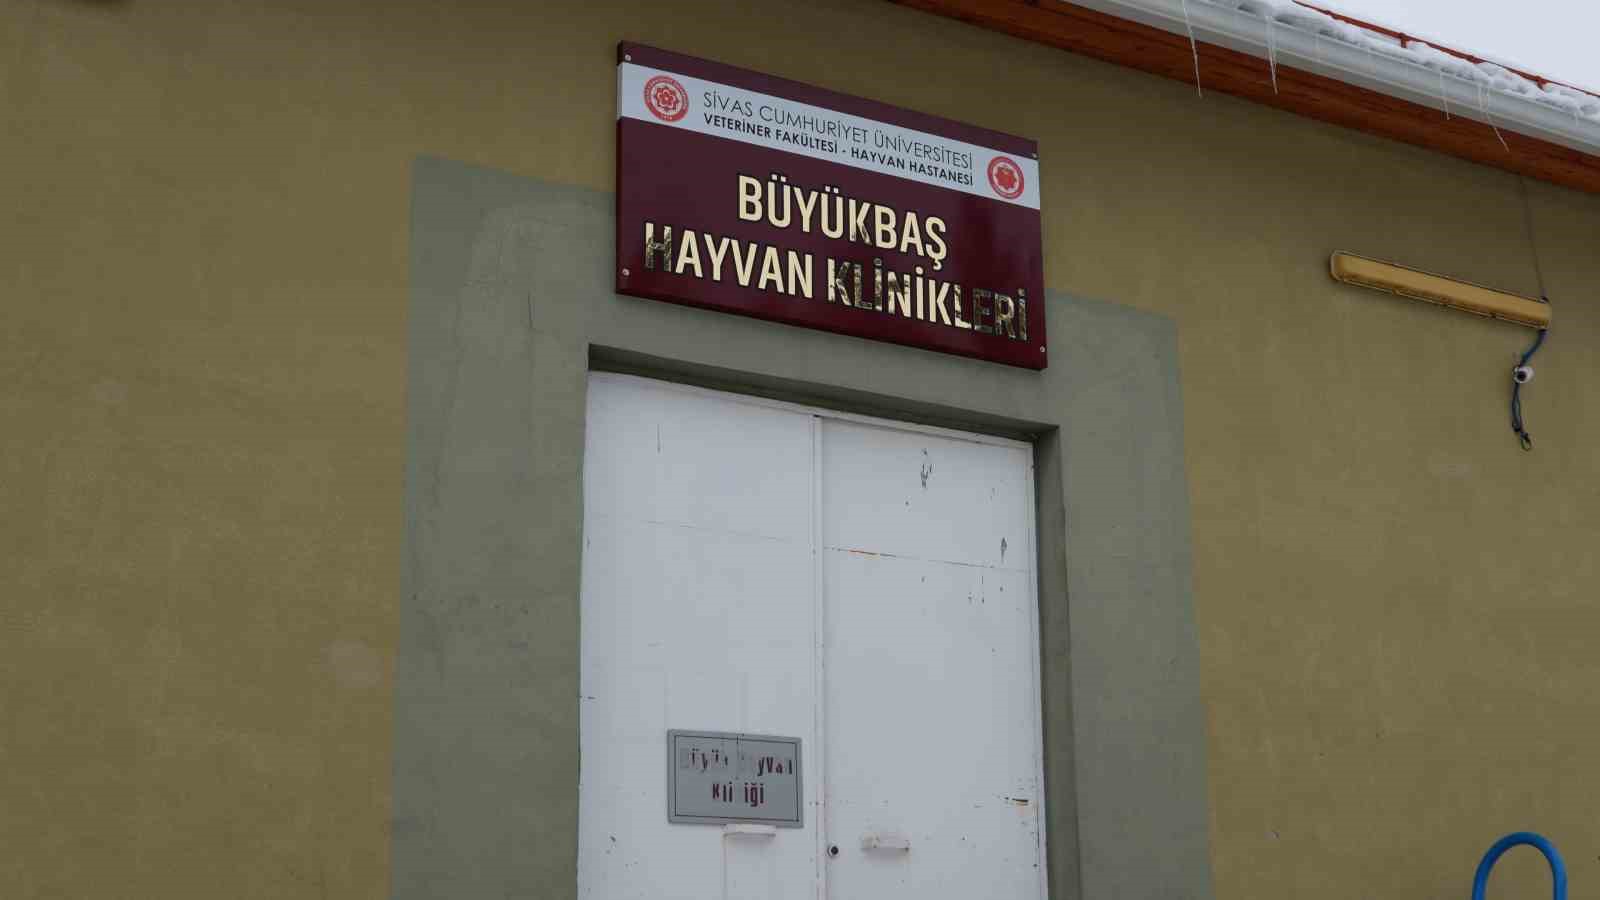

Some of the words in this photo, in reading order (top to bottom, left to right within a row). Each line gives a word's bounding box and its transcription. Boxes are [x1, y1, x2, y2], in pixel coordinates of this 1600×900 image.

[704, 91, 753, 117] SİVAS
[759, 105, 868, 144] CUMHURİYET
[874, 129, 973, 170] ÜNİVERSİTESİ
[704, 112, 771, 138] VETERİNER
[775, 128, 838, 154] FAKÜLTESİ
[851, 146, 905, 170] HAYVAN
[737, 173, 948, 271] BÜYÜKBAŞ
[644, 221, 814, 299] HAYVAN
[826, 256, 1028, 341] KLİNİKLERİ
[711, 781, 765, 808] Kliiği
